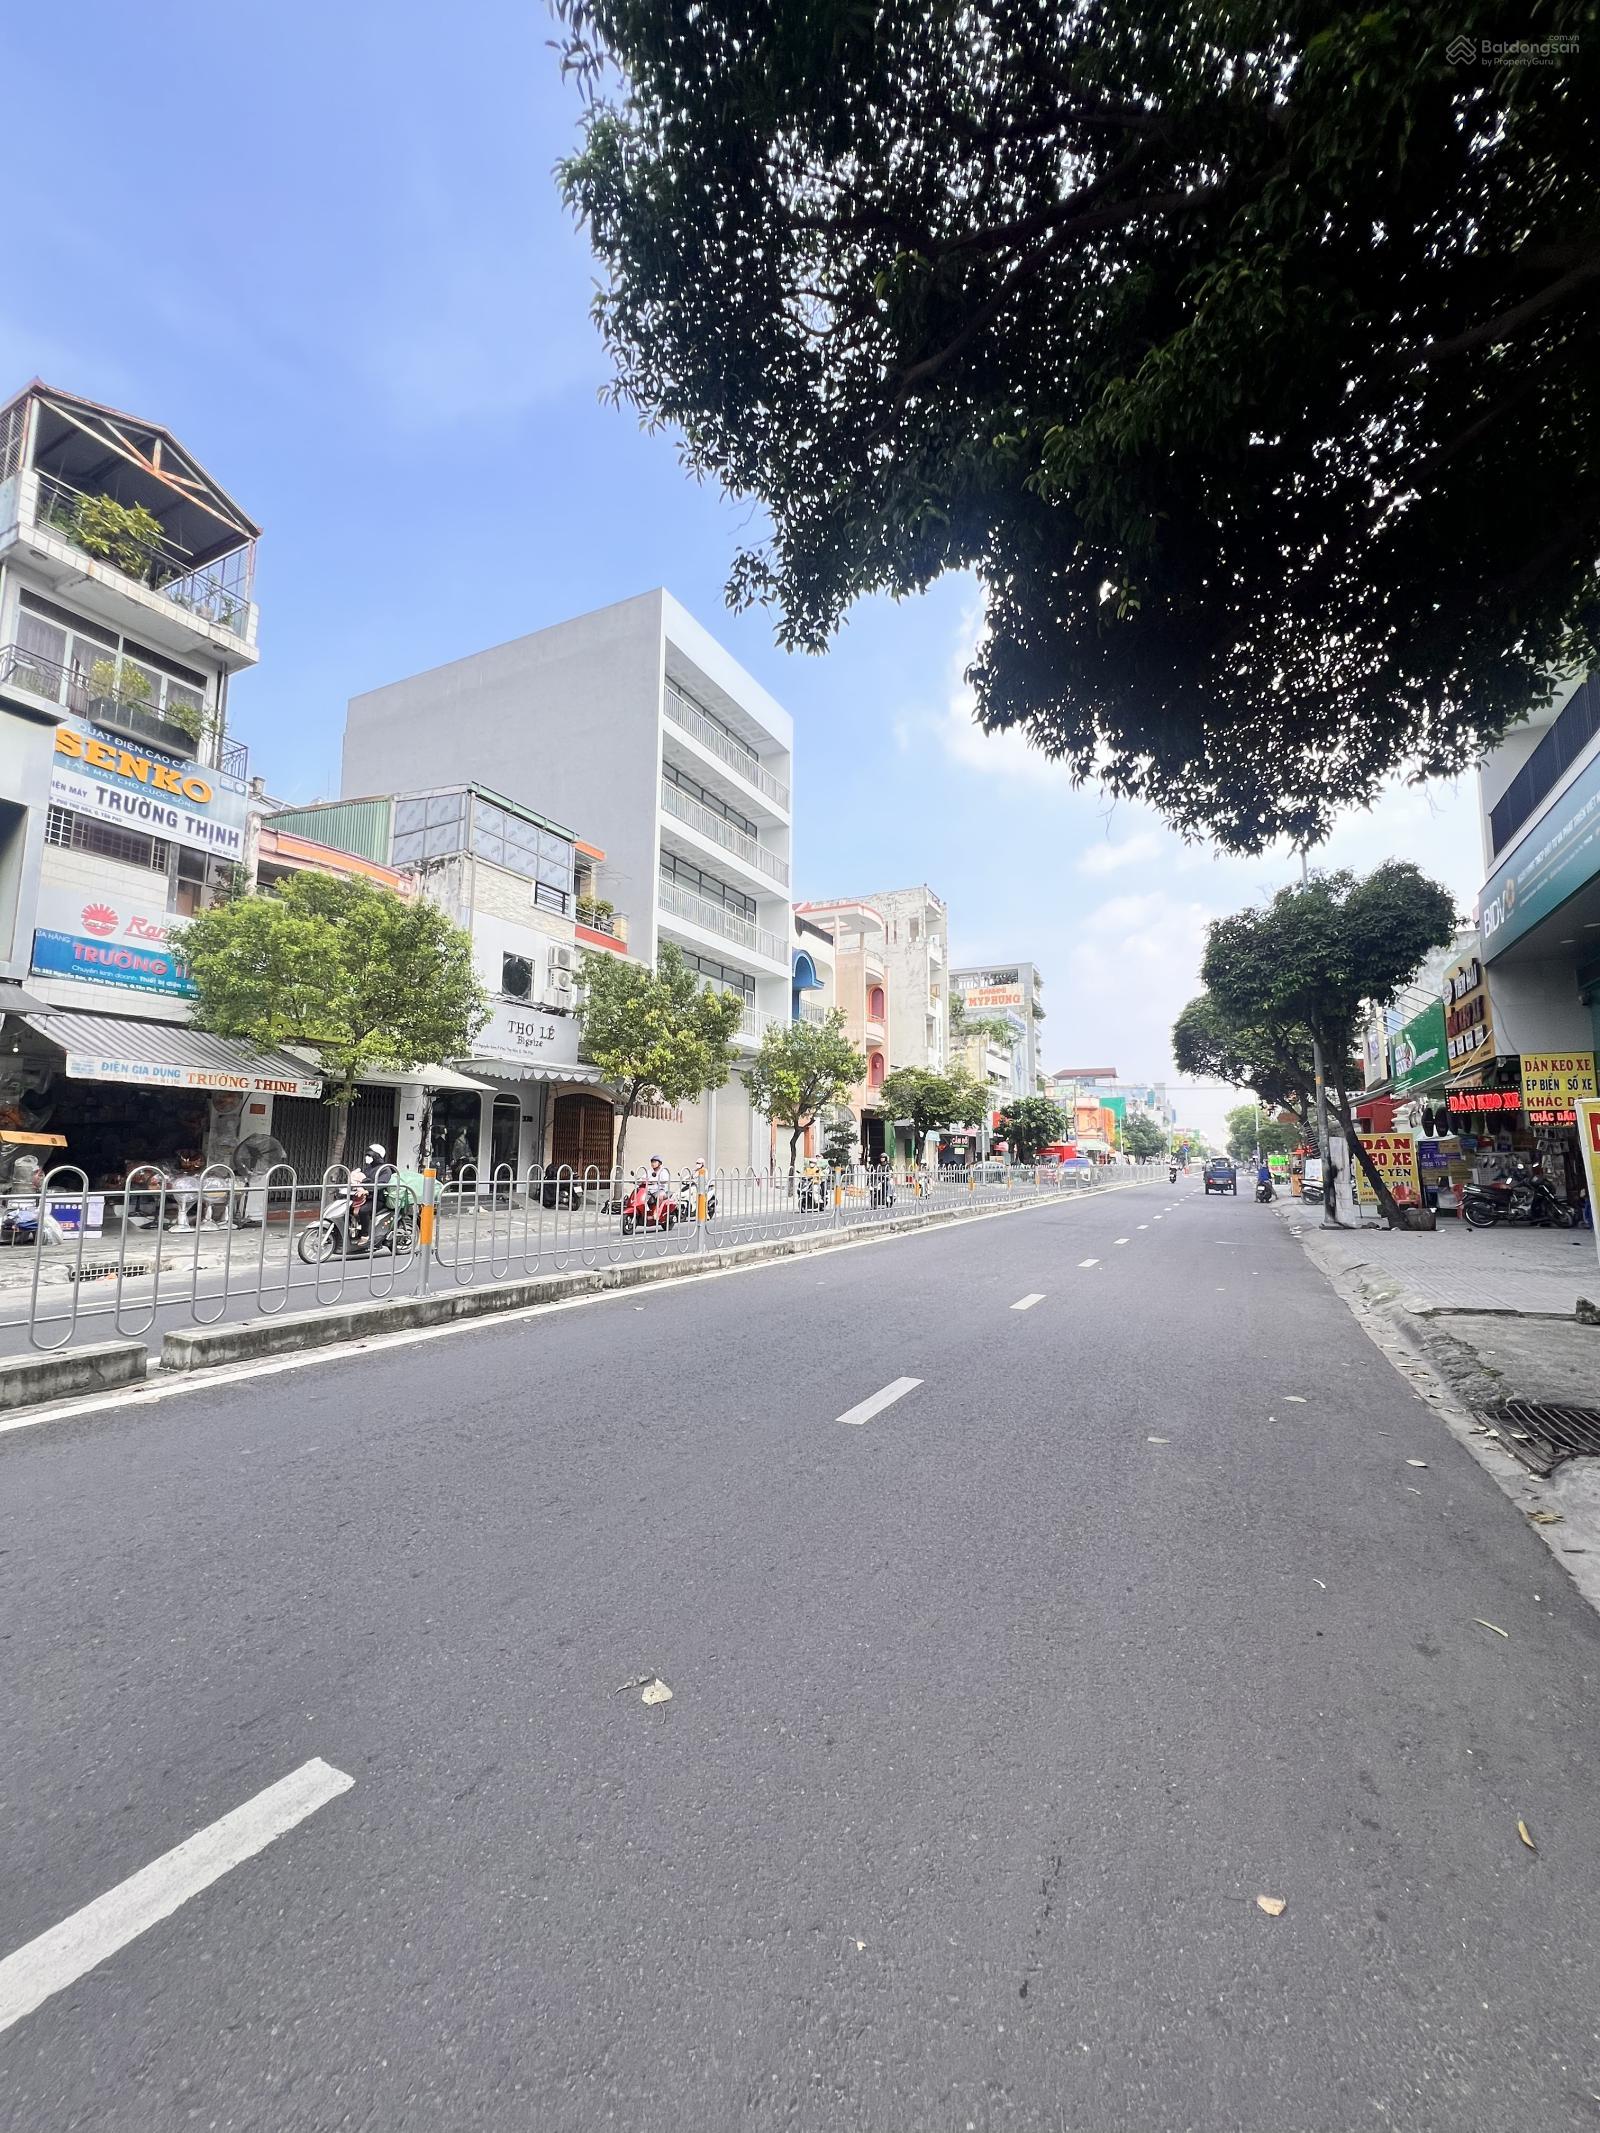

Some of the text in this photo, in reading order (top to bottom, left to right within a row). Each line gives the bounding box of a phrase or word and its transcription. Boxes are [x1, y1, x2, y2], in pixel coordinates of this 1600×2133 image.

[145, 749, 170, 764] CAO
[55, 727, 213, 804] SENKO
[51, 779, 67, 791] IỆN
[117, 777, 139, 790] CHO
[96, 785, 240, 849] TRƯỜNG THỊNH
[1484, 890, 1507, 939] BIDV
[124, 915, 169, 941] Ran
[132, 1065, 149, 1075] GIA
[1551, 1060, 1574, 1072] KEO
[1576, 1059, 1592, 1071] XE
[186, 1070, 250, 1089] TRƯỜNG
[1582, 1078, 1592, 1091] XE
[1477, 1094, 1502, 1110] KEO
[1503, 1092, 1521, 1108] XE
[1368, 1152, 1387, 1166] EO
[1392, 1152, 1412, 1166] XE
